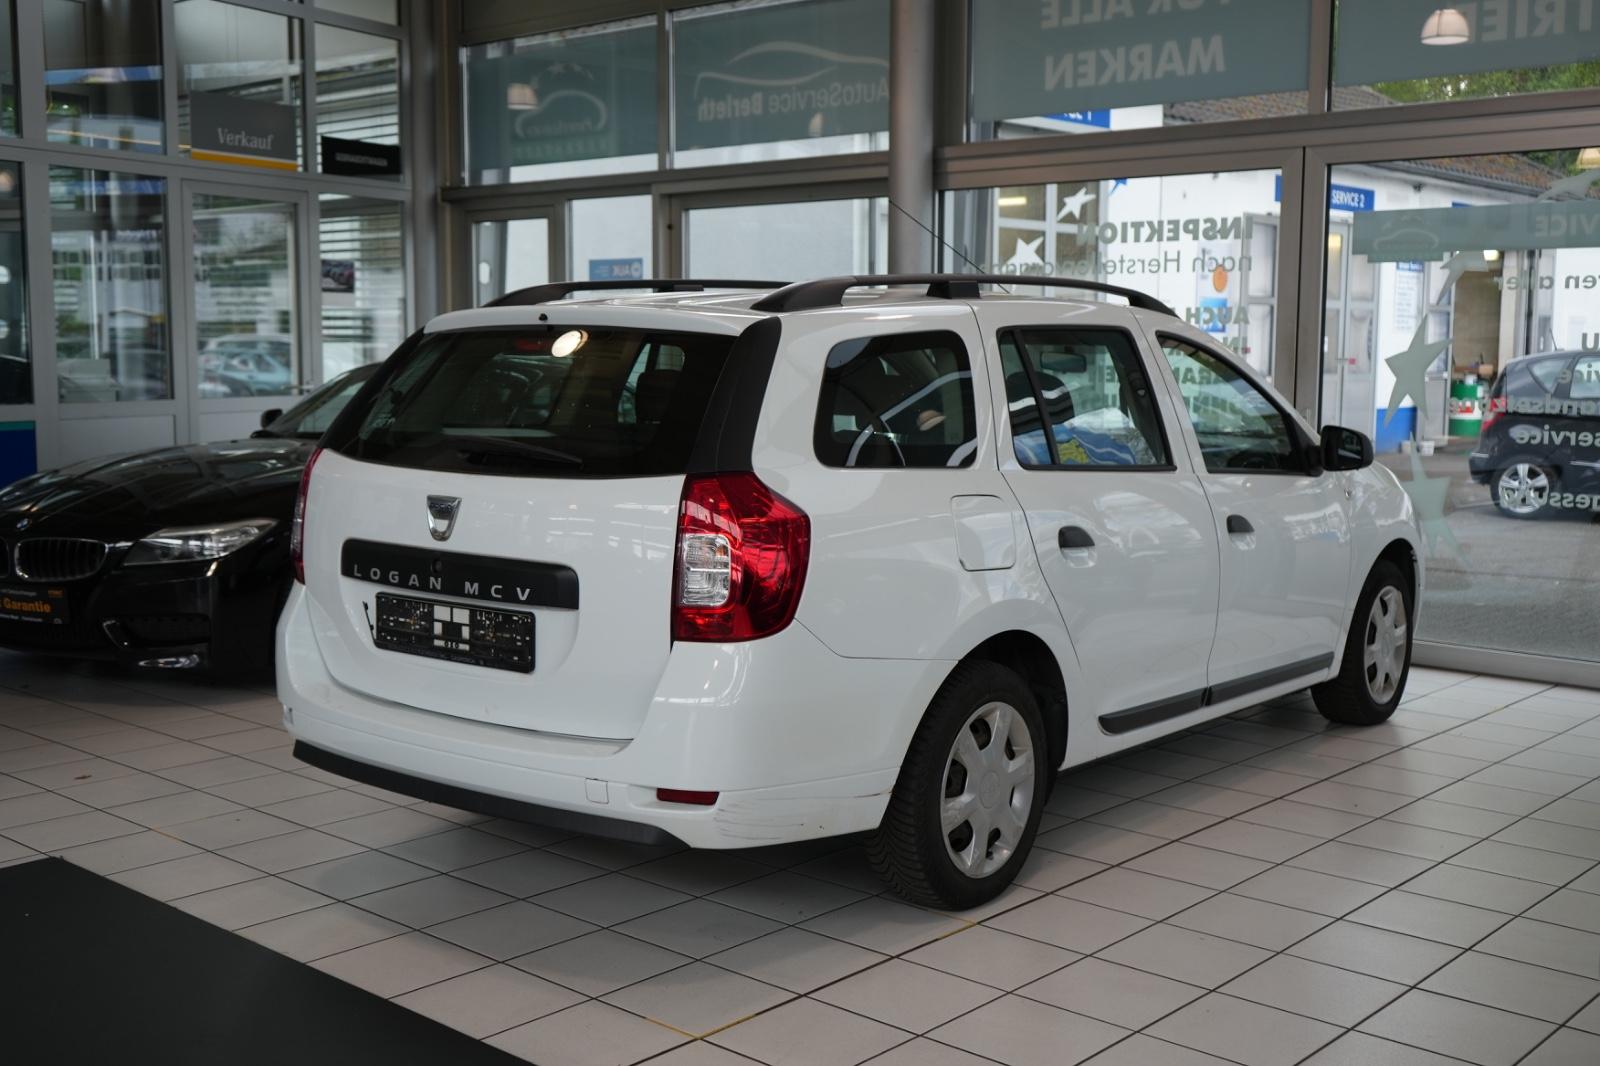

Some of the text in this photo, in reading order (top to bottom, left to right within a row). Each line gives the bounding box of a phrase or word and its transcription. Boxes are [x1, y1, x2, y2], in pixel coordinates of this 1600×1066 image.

[217, 127, 275, 151] Verkauf
[1332, 189, 1359, 209] SERVICE
[352, 563, 531, 602] LOGAN MCV
[3, 597, 51, 613] Garantie
